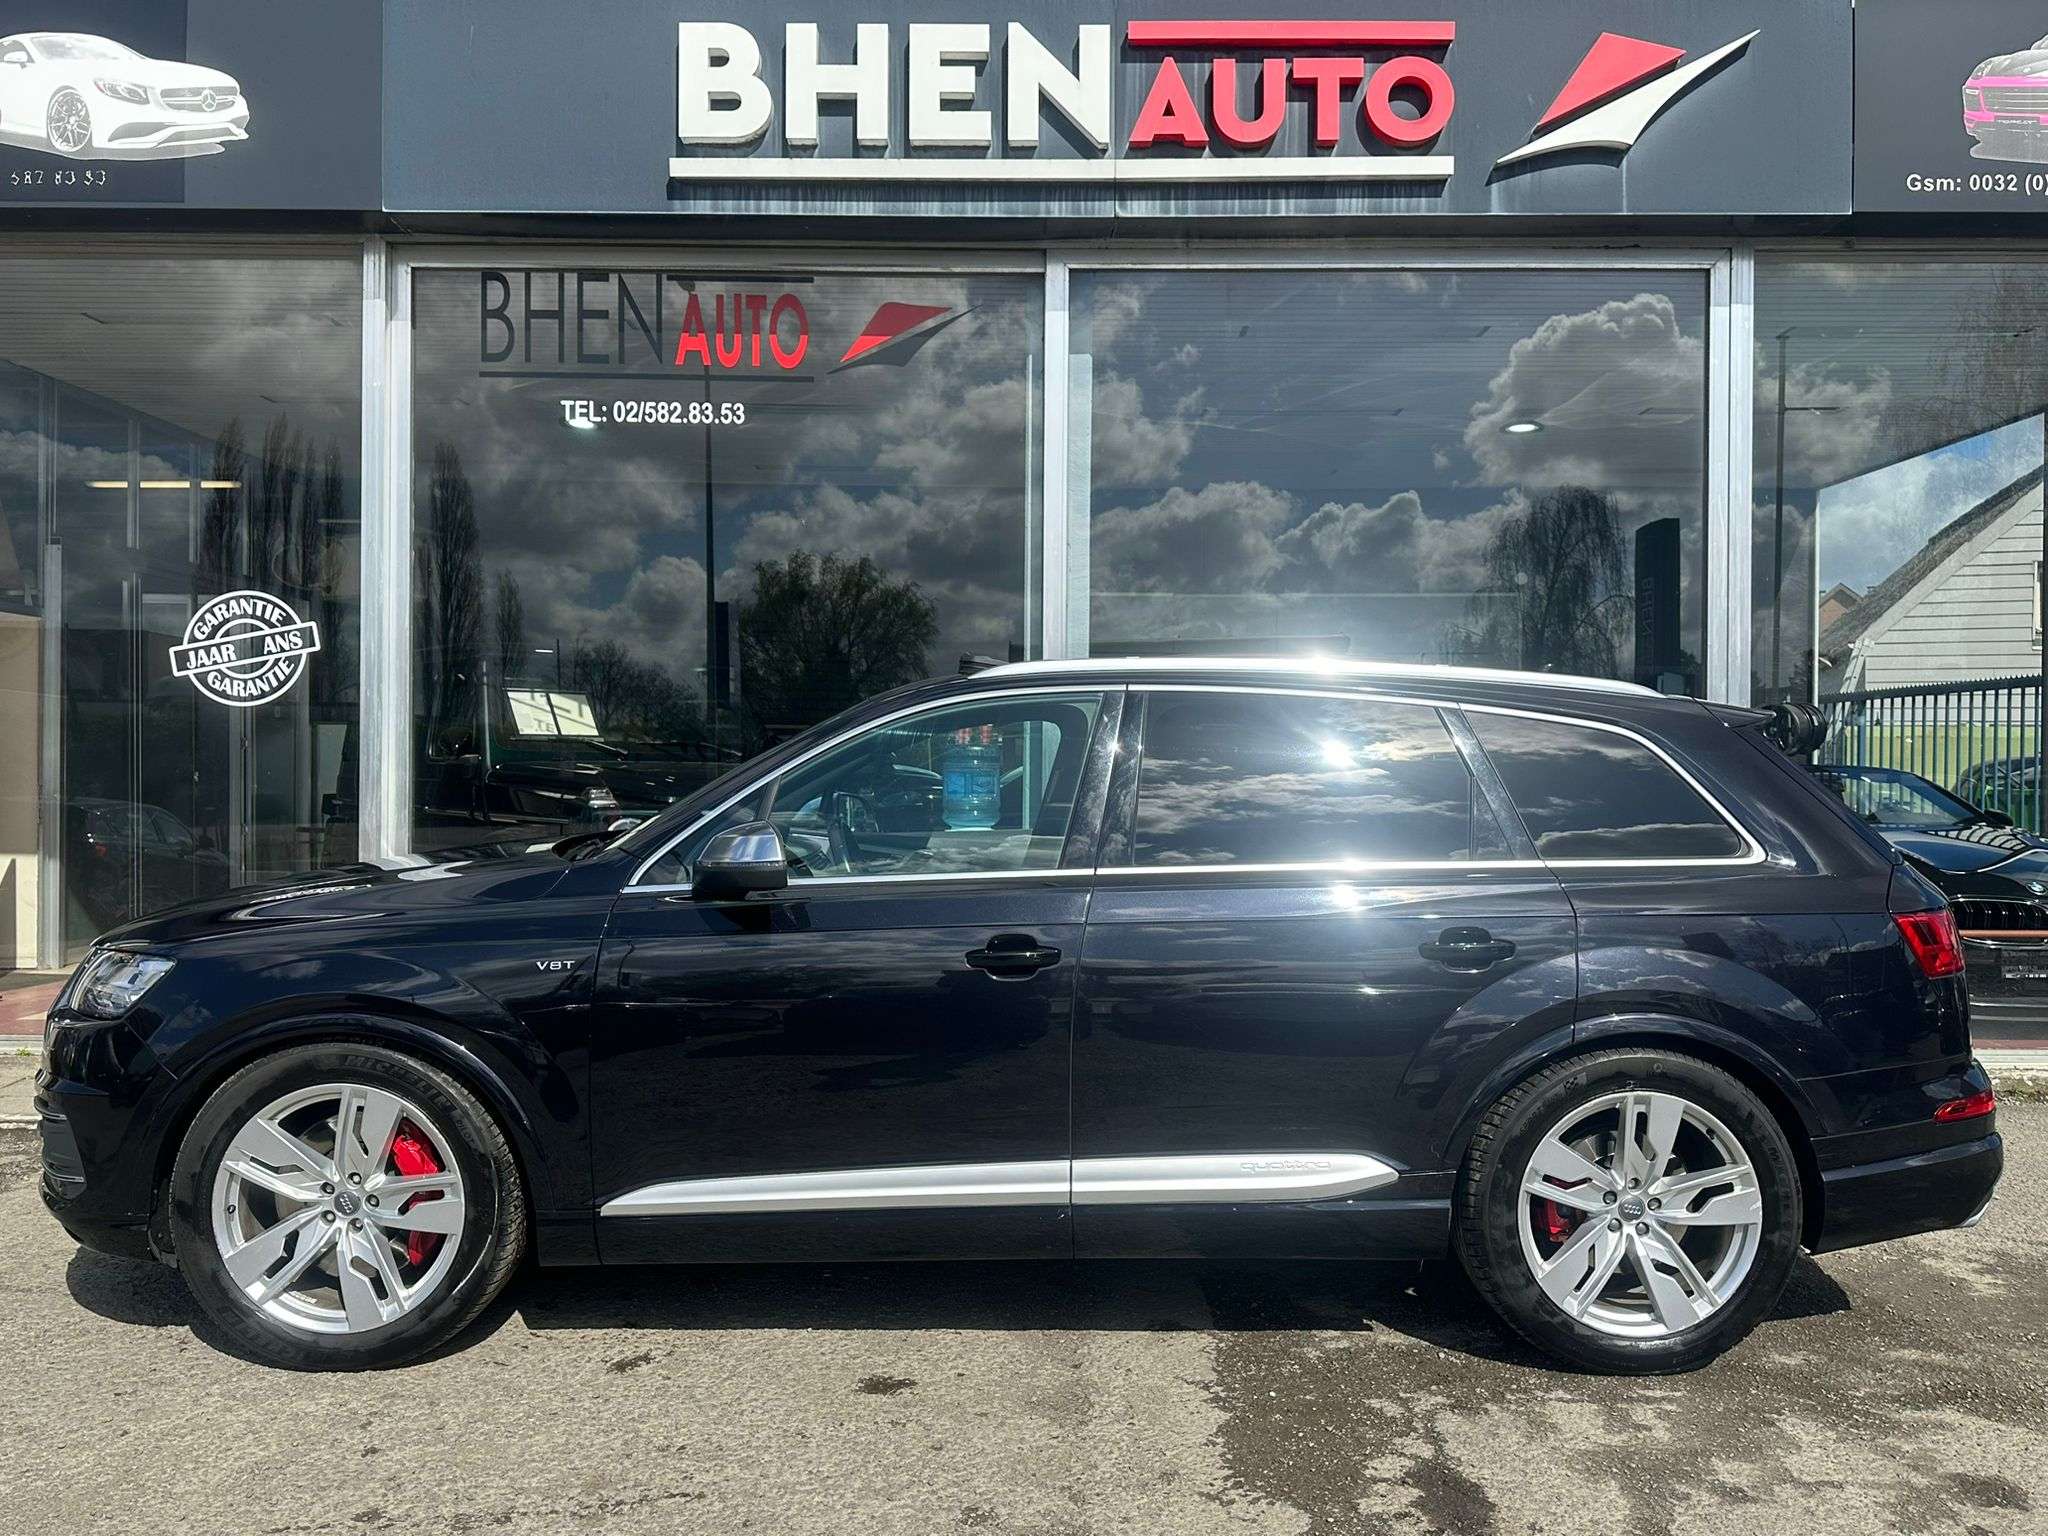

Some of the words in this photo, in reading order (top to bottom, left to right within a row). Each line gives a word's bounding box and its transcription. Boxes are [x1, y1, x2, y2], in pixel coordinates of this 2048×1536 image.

[678, 21, 1111, 148] BHEN
[1129, 55, 1456, 149] AUTO
[1906, 173, 1962, 192] Gsm:
[1969, 173, 2018, 192] 0032
[480, 271, 664, 364] BHEN
[675, 292, 809, 369] AUTO
[560, 400, 607, 423] TEL:
[612, 400, 746, 425] 02/582.83.53
[193, 598, 287, 640] GARANTIE
[186, 643, 237, 669] JAAR
[263, 630, 303, 655] ANS
[207, 656, 295, 697] GARANTIE
[535, 960, 576, 970] V8T
[1240, 1160, 1331, 1174] quattro
